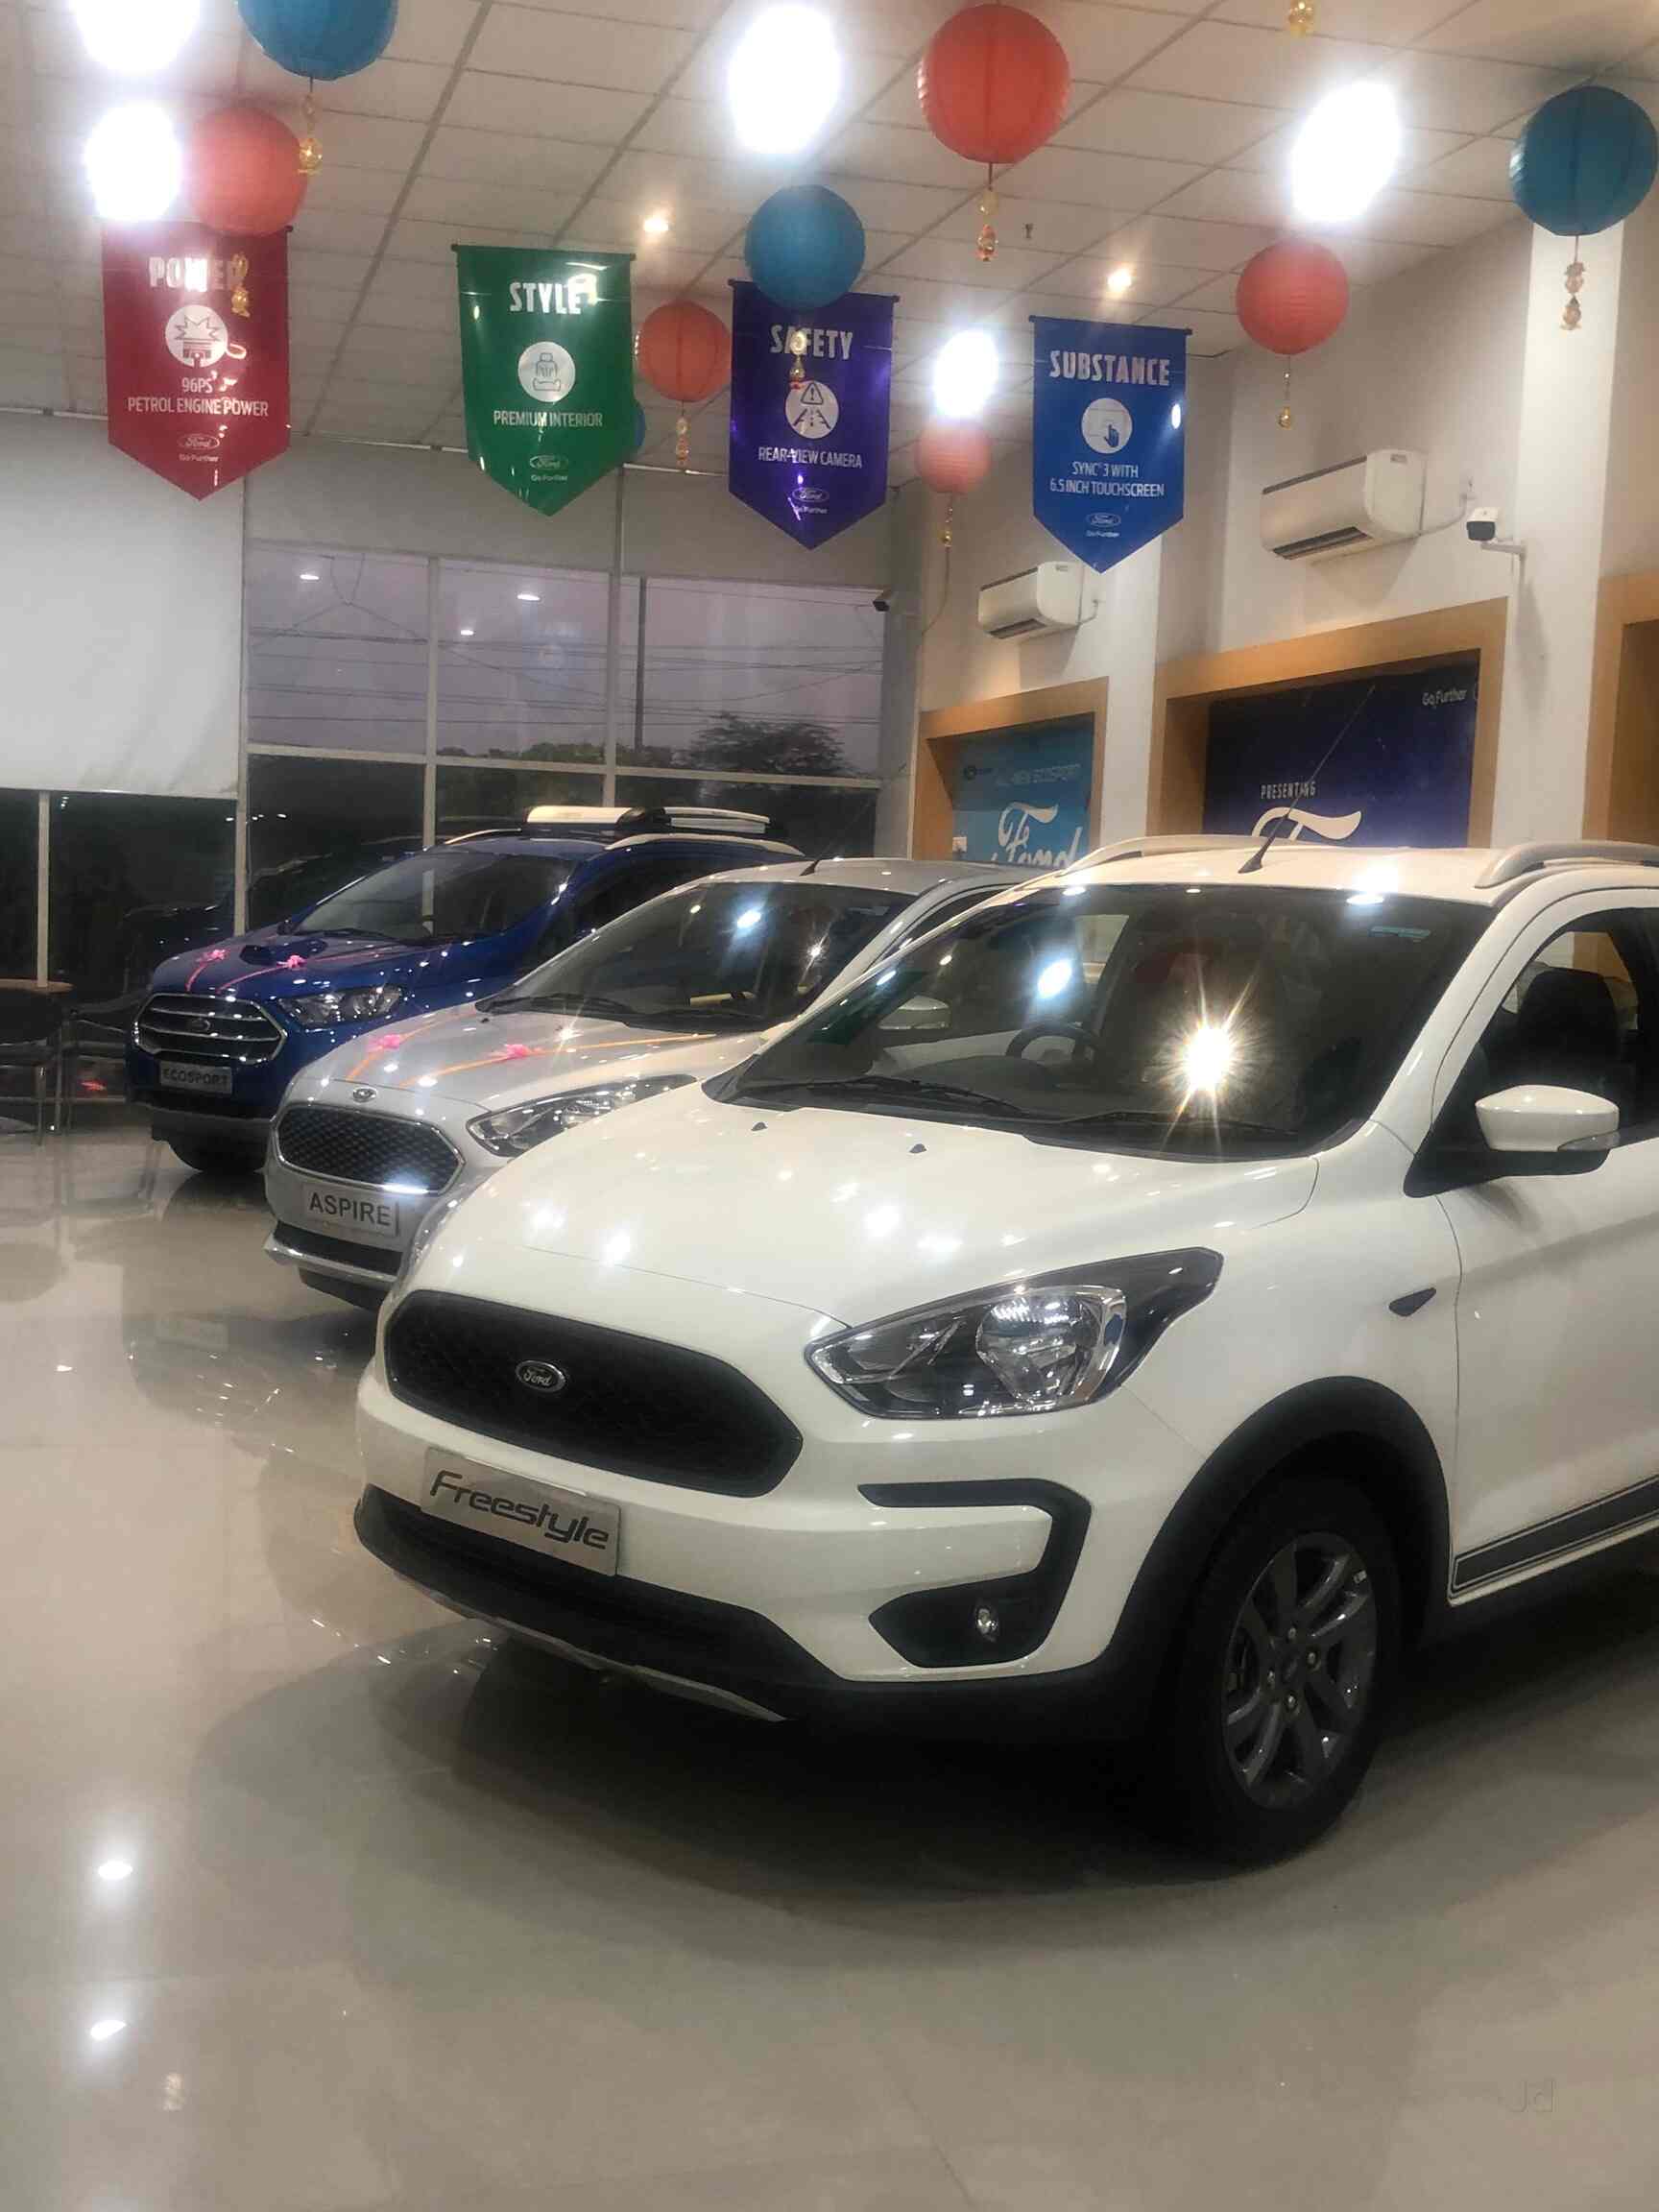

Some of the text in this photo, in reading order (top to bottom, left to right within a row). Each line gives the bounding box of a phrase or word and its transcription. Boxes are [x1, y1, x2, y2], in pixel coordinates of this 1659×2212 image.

[509, 281, 582, 315] STYLE
[1049, 349, 1170, 386] SUBSTANCE
[127, 397, 269, 418] PETROL ENGINE POWER
[493, 410, 603, 428] PREMIUM INTERIOR
[819, 449, 863, 469] CAMERA
[1110, 462, 1140, 478] WITH
[1065, 478, 1090, 494] INCH
[1091, 478, 1166, 497] TOUCHSCREEN
[1260, 781, 1317, 800] PRESENTING
[309, 1191, 392, 1227] ASPIRE
[522, 1365, 553, 1386] Ford
[429, 1469, 610, 1551] Freestyle
